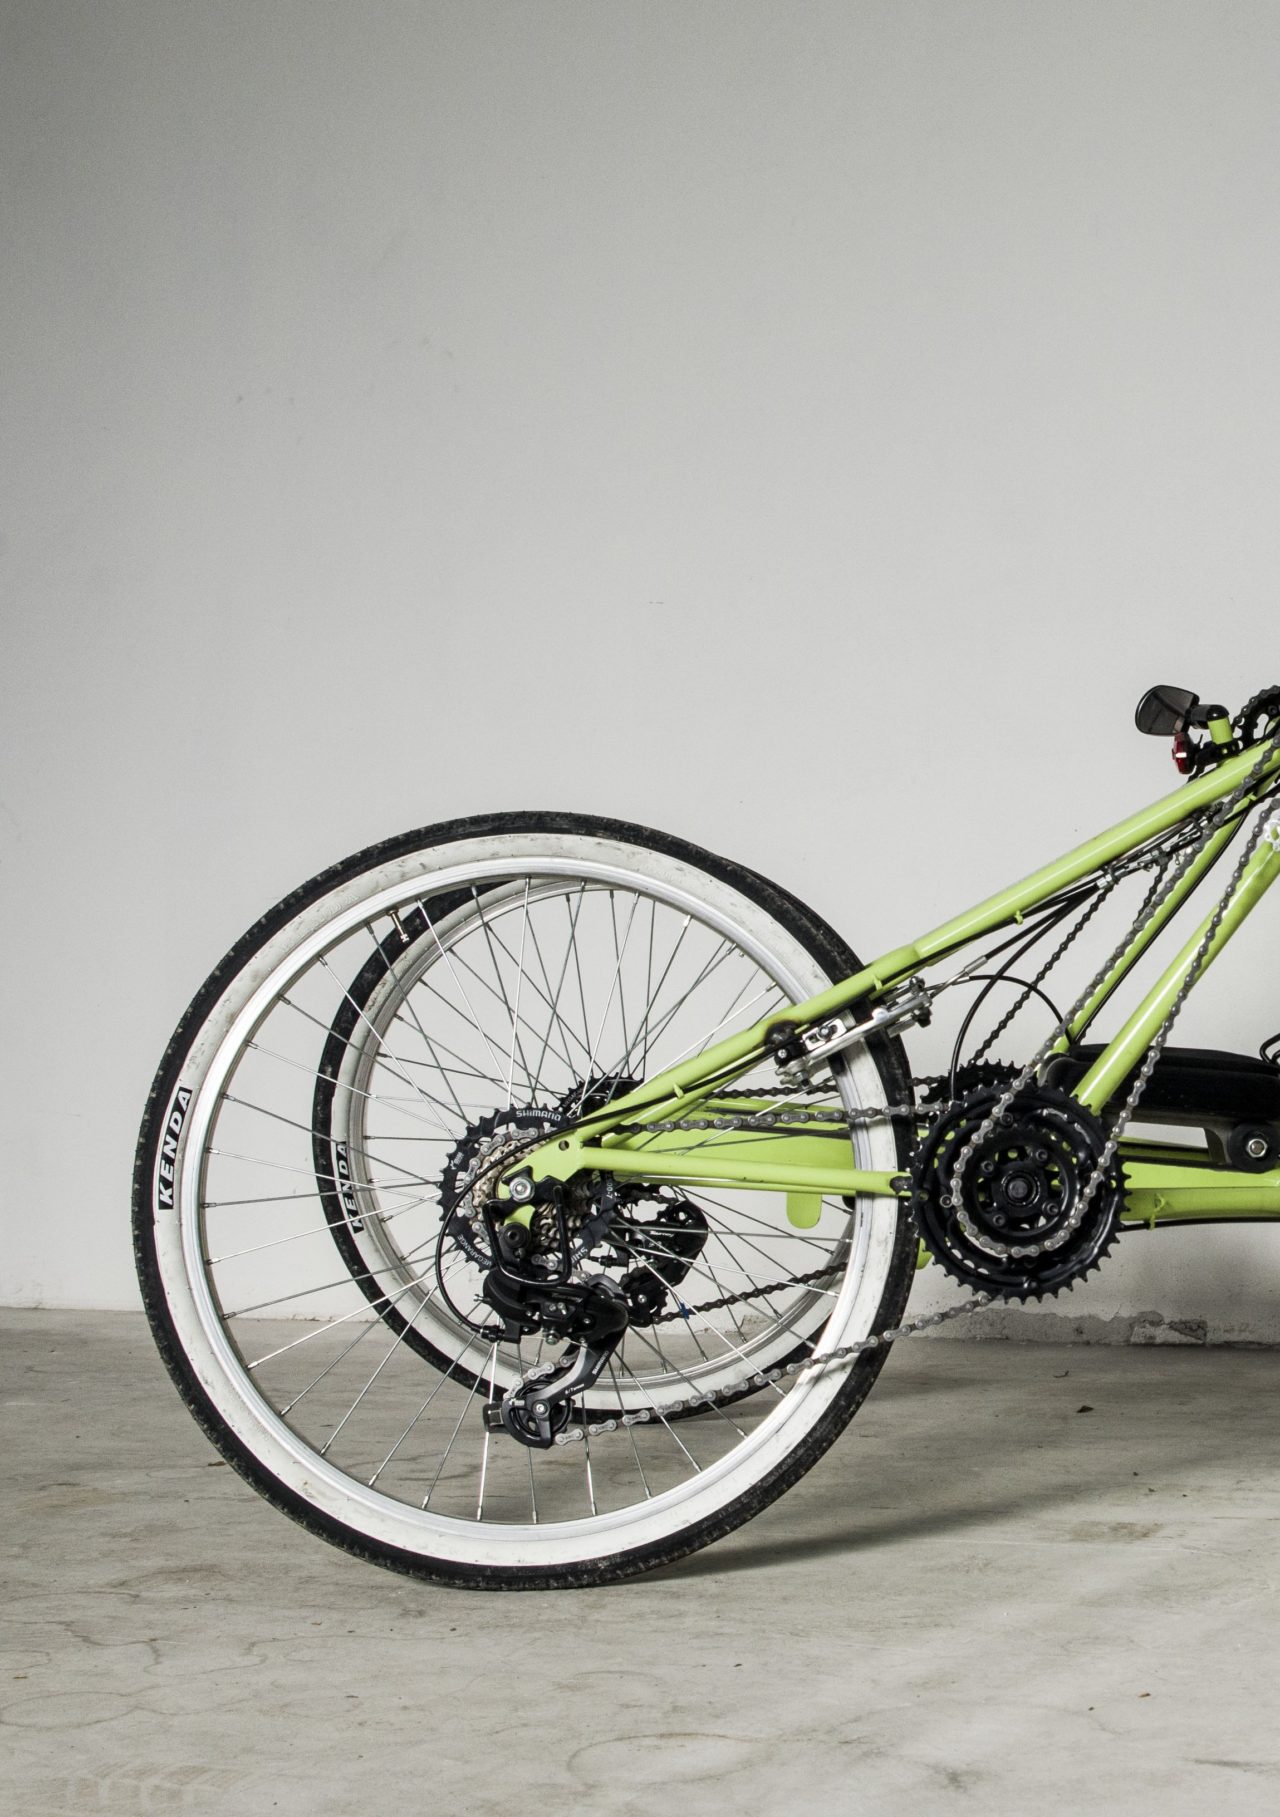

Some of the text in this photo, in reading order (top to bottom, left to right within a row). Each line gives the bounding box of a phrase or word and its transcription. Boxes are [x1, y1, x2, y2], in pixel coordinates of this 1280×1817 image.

[159, 1089, 192, 1206] KENDA
[515, 1107, 562, 1122] SHIMANO
[336, 1142, 363, 1229] KENDA
